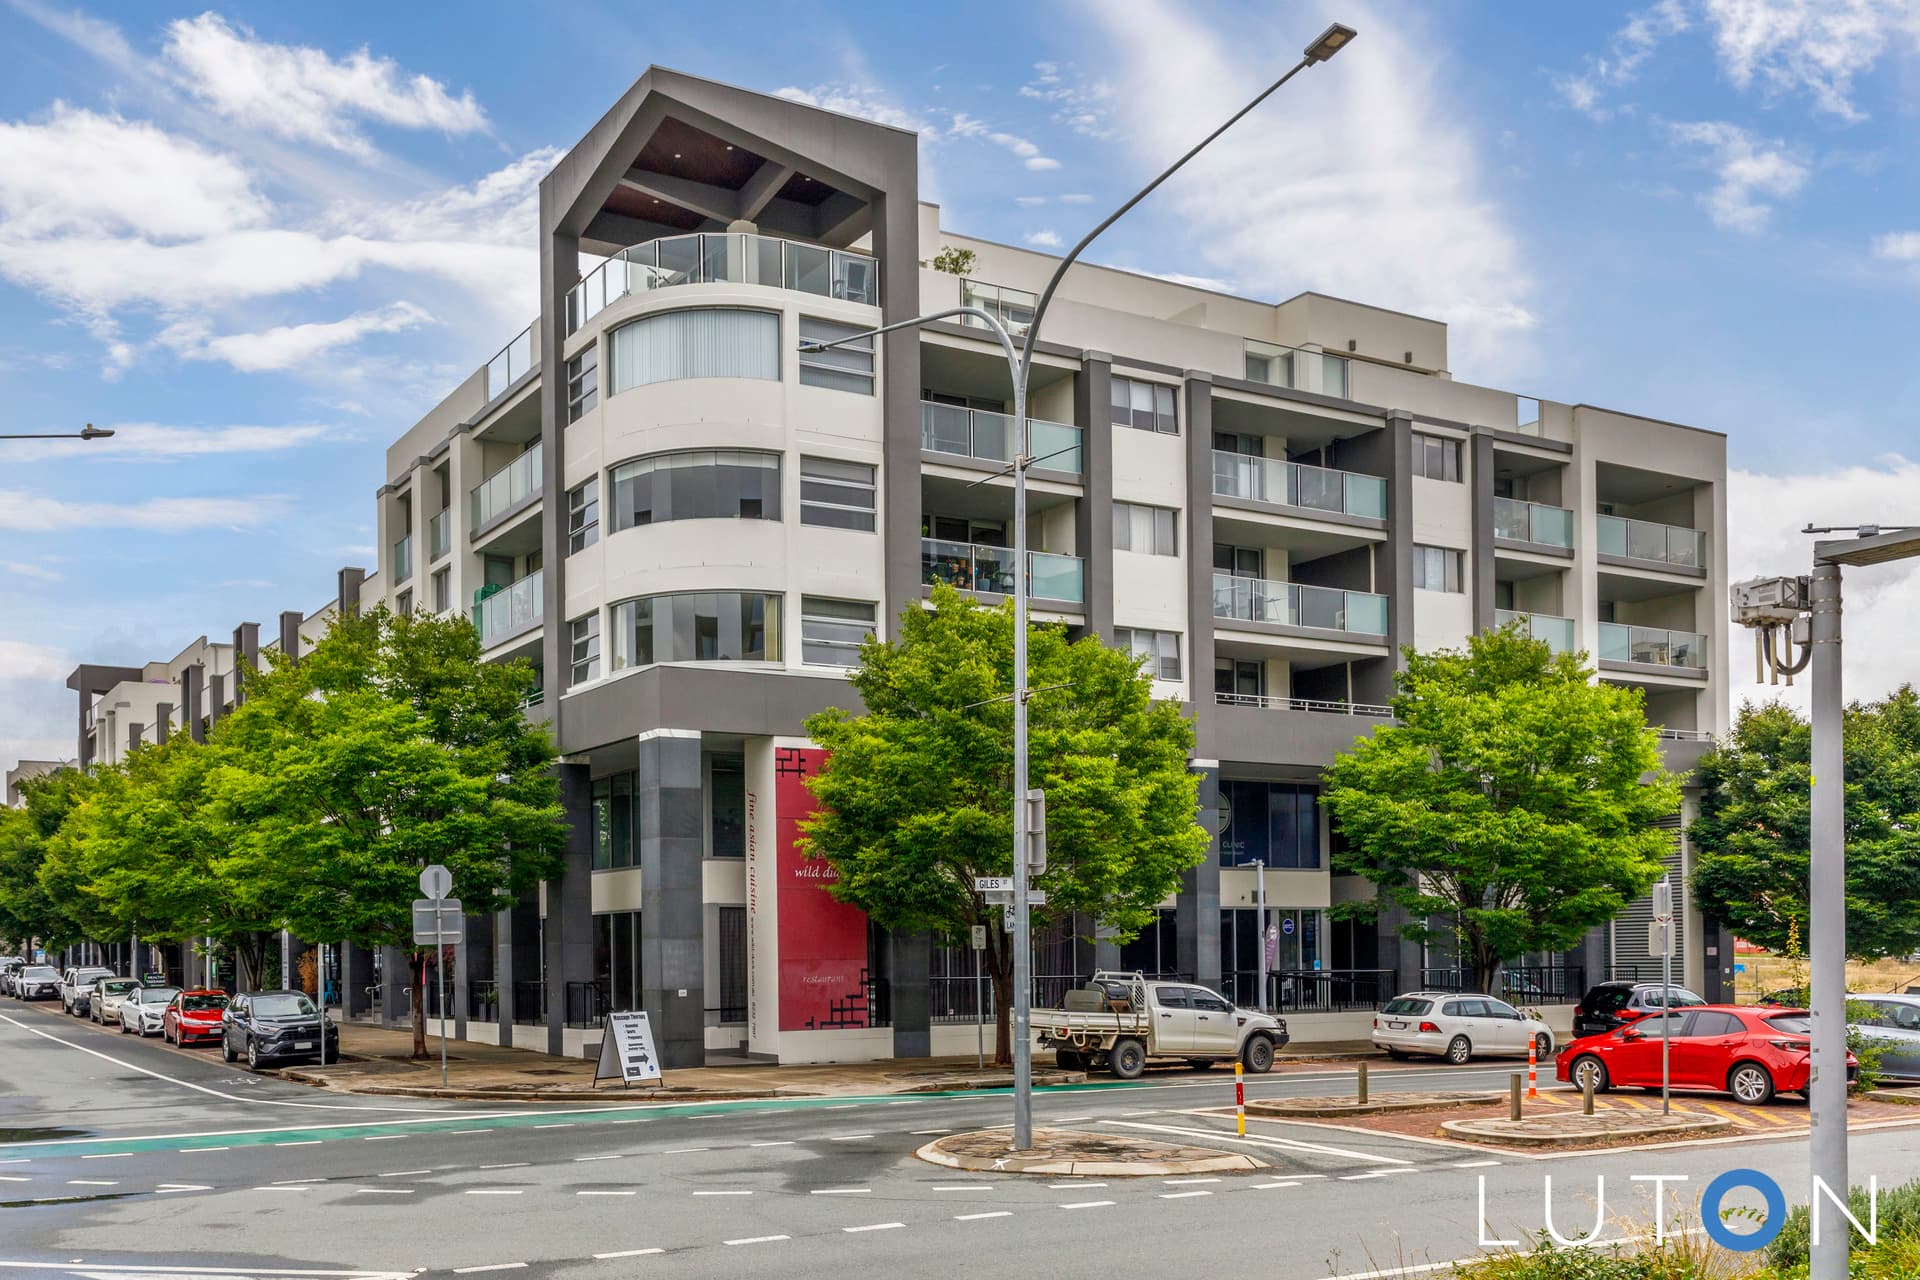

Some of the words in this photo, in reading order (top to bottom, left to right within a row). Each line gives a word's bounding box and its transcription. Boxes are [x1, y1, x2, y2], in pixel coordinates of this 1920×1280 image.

[748, 792, 757, 820] fine
[749, 824, 757, 861] asian
[1222, 841, 1244, 849] CLINIC
[795, 865, 820, 878] wild
[979, 880, 1000, 889] GILES
[802, 975, 844, 983] restaurant
